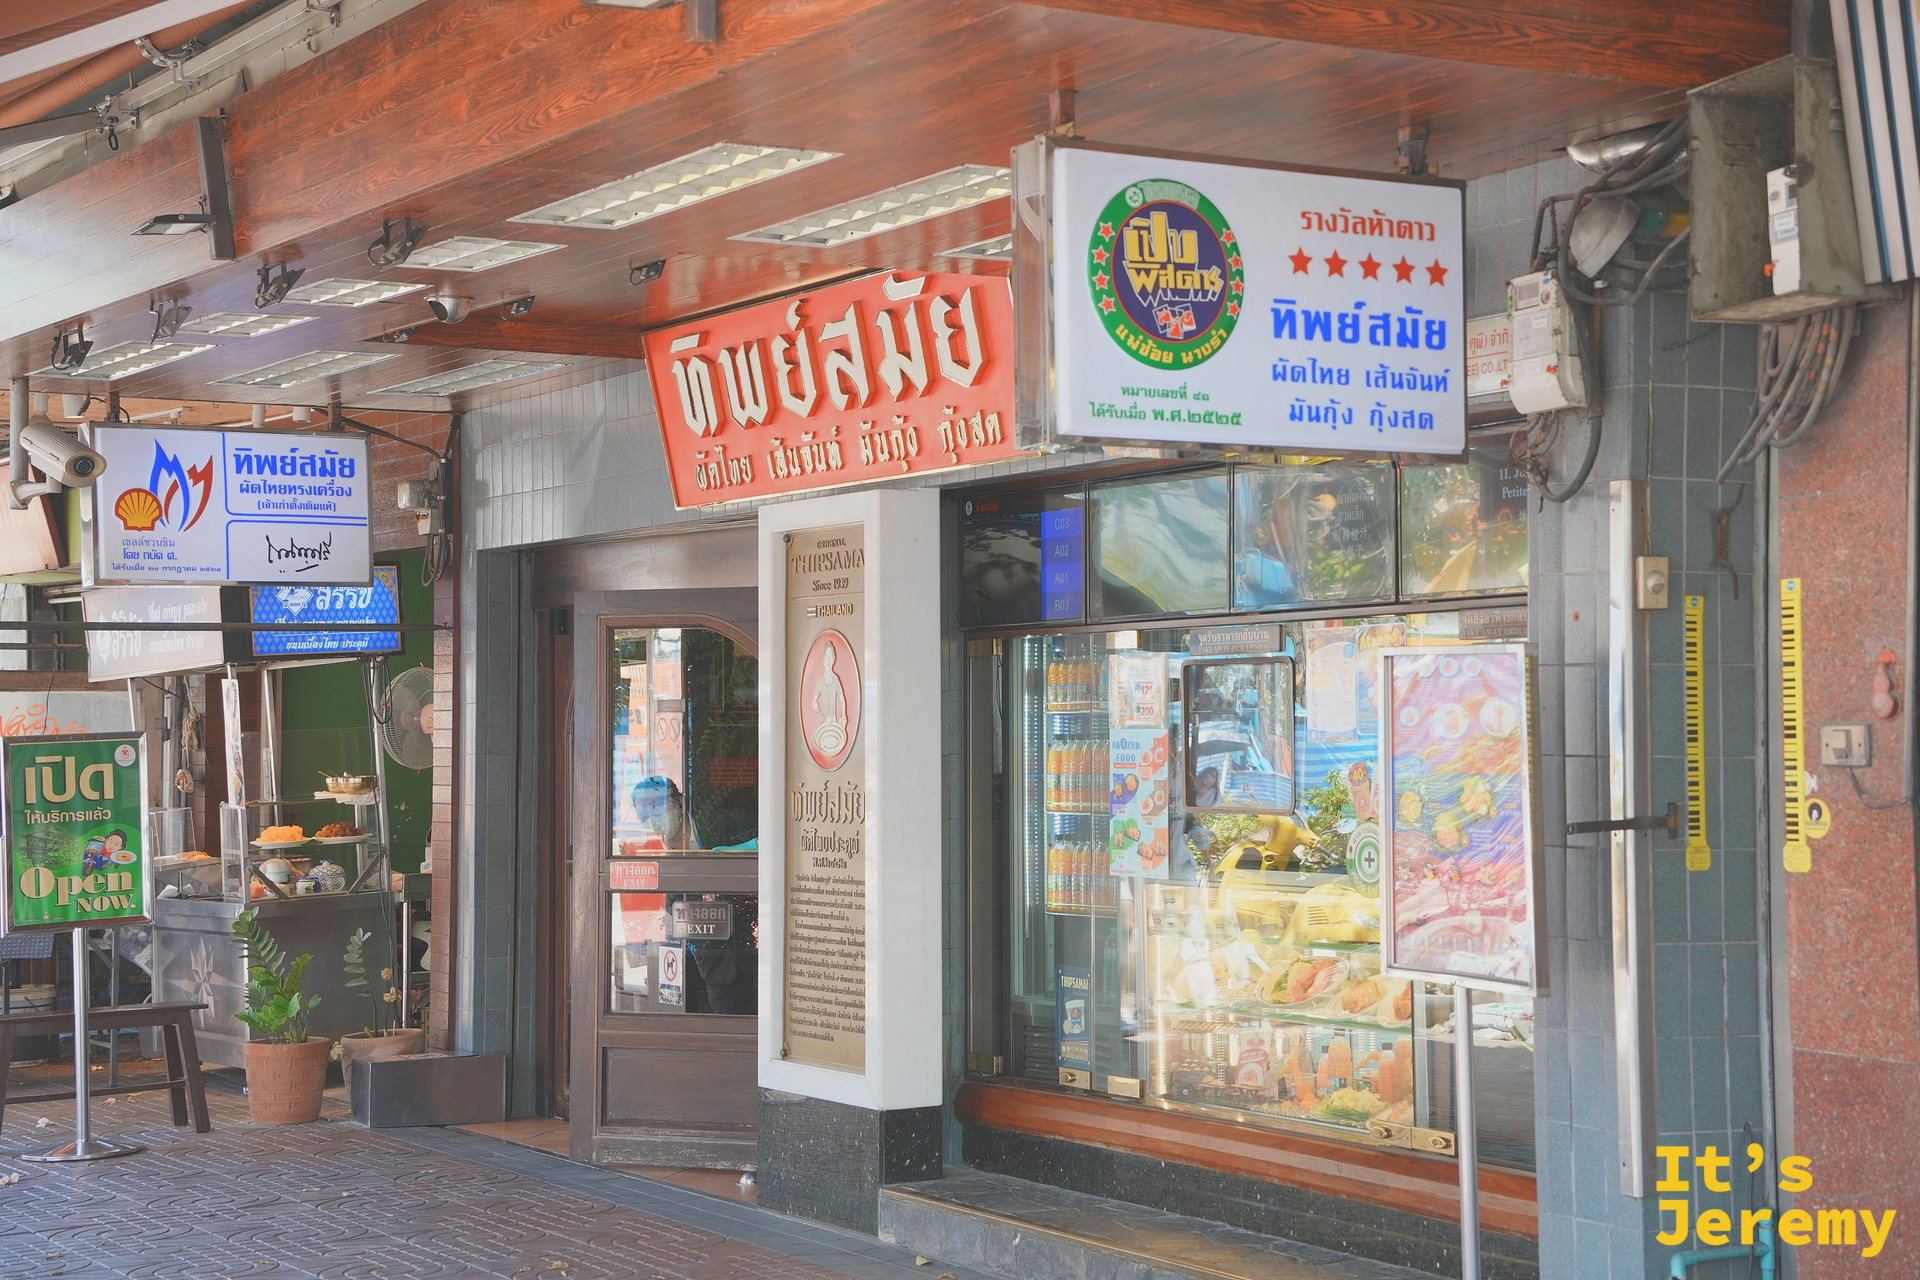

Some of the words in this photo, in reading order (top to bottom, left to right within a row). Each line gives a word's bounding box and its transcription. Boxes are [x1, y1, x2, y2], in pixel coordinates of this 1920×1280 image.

[1300, 207, 1435, 241] รางวัลห้าดาว
[1124, 212, 1198, 264] เปิบ
[1124, 262, 1223, 302] พิสดาร
[1271, 298, 1446, 350] ทิพย์สมัย
[1115, 323, 1174, 364] แม่ช้อย
[1180, 327, 1228, 364] นางรำ
[1490, 328, 1509, 347] จำกั
[670, 274, 990, 438] ทิพย์สมัย
[1272, 357, 1350, 386] ผัดไทย
[1365, 363, 1450, 393] เส้นจันท์
[1481, 359, 1509, 375] CO.,LT
[1121, 382, 1187, 400] หมายเลขที่
[1089, 401, 1147, 421] ได้รับเมื่อ
[1289, 397, 1353, 430] มันกุ้ง
[1369, 402, 1434, 433] กุ้งสด
[695, 444, 754, 491] ผัดไทย
[766, 426, 845, 481] เส้นจันท์
[858, 414, 918, 472] มันกุ้ง
[937, 405, 1004, 465] กุ้งสด
[233, 447, 356, 479] ทิพย์สมัย
[240, 479, 353, 497] ผัดไทยทรงเครื่อง
[1054, 518, 1070, 530] C03
[122, 535, 176, 548] เชลล์ชวนชิม
[123, 547, 140, 560] โดย
[143, 549, 163, 560] ถนัด
[167, 551, 178, 560] ศ.
[1054, 545, 1069, 557] A02
[111, 562, 145, 571] ได้รับเมื่อ
[161, 565, 197, 573] กรกฎาคม
[792, 548, 865, 575] THIPSAMA
[812, 579, 832, 592] Since
[833, 577, 849, 590] 1939
[1054, 572, 1069, 584] A01
[815, 603, 854, 618] THAILAND
[1054, 599, 1069, 611] B03
[1198, 627, 1270, 647] จุดรับอาหารกลับบ้าน
[1141, 706, 1154, 717] 200
[1112, 737, 1140, 750] FROZEN
[1116, 753, 1136, 762] FOOD
[24, 755, 114, 804] เปิด
[25, 807, 112, 825] ให้บริการแล้ว
[614, 865, 656, 876] ทางออก
[19, 866, 134, 907] Open
[623, 879, 646, 887] EXIT
[676, 907, 726, 920] ทางออก
[686, 924, 716, 934] EXIT
[1061, 976, 1089, 990] THIPSAMAI
